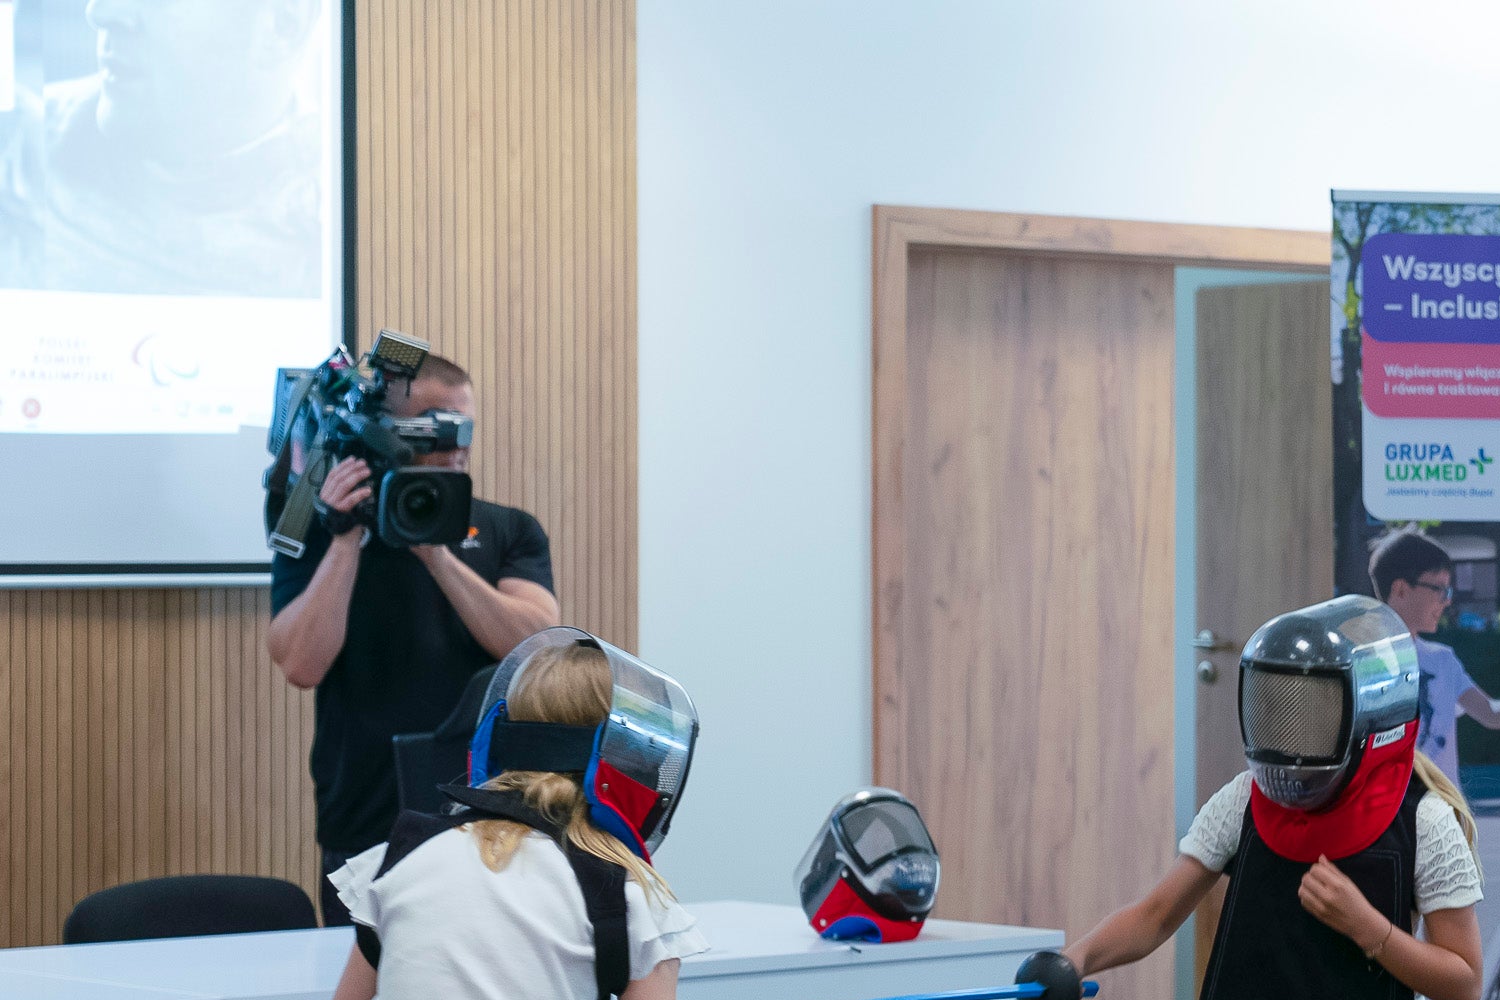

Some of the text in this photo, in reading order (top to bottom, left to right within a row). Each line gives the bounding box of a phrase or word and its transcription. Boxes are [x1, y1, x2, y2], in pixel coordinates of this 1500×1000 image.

[1384, 364, 1463, 381] Wspieramy
[1385, 443, 1454, 461] GRUPA
[1385, 463, 1467, 482] LUXMED
